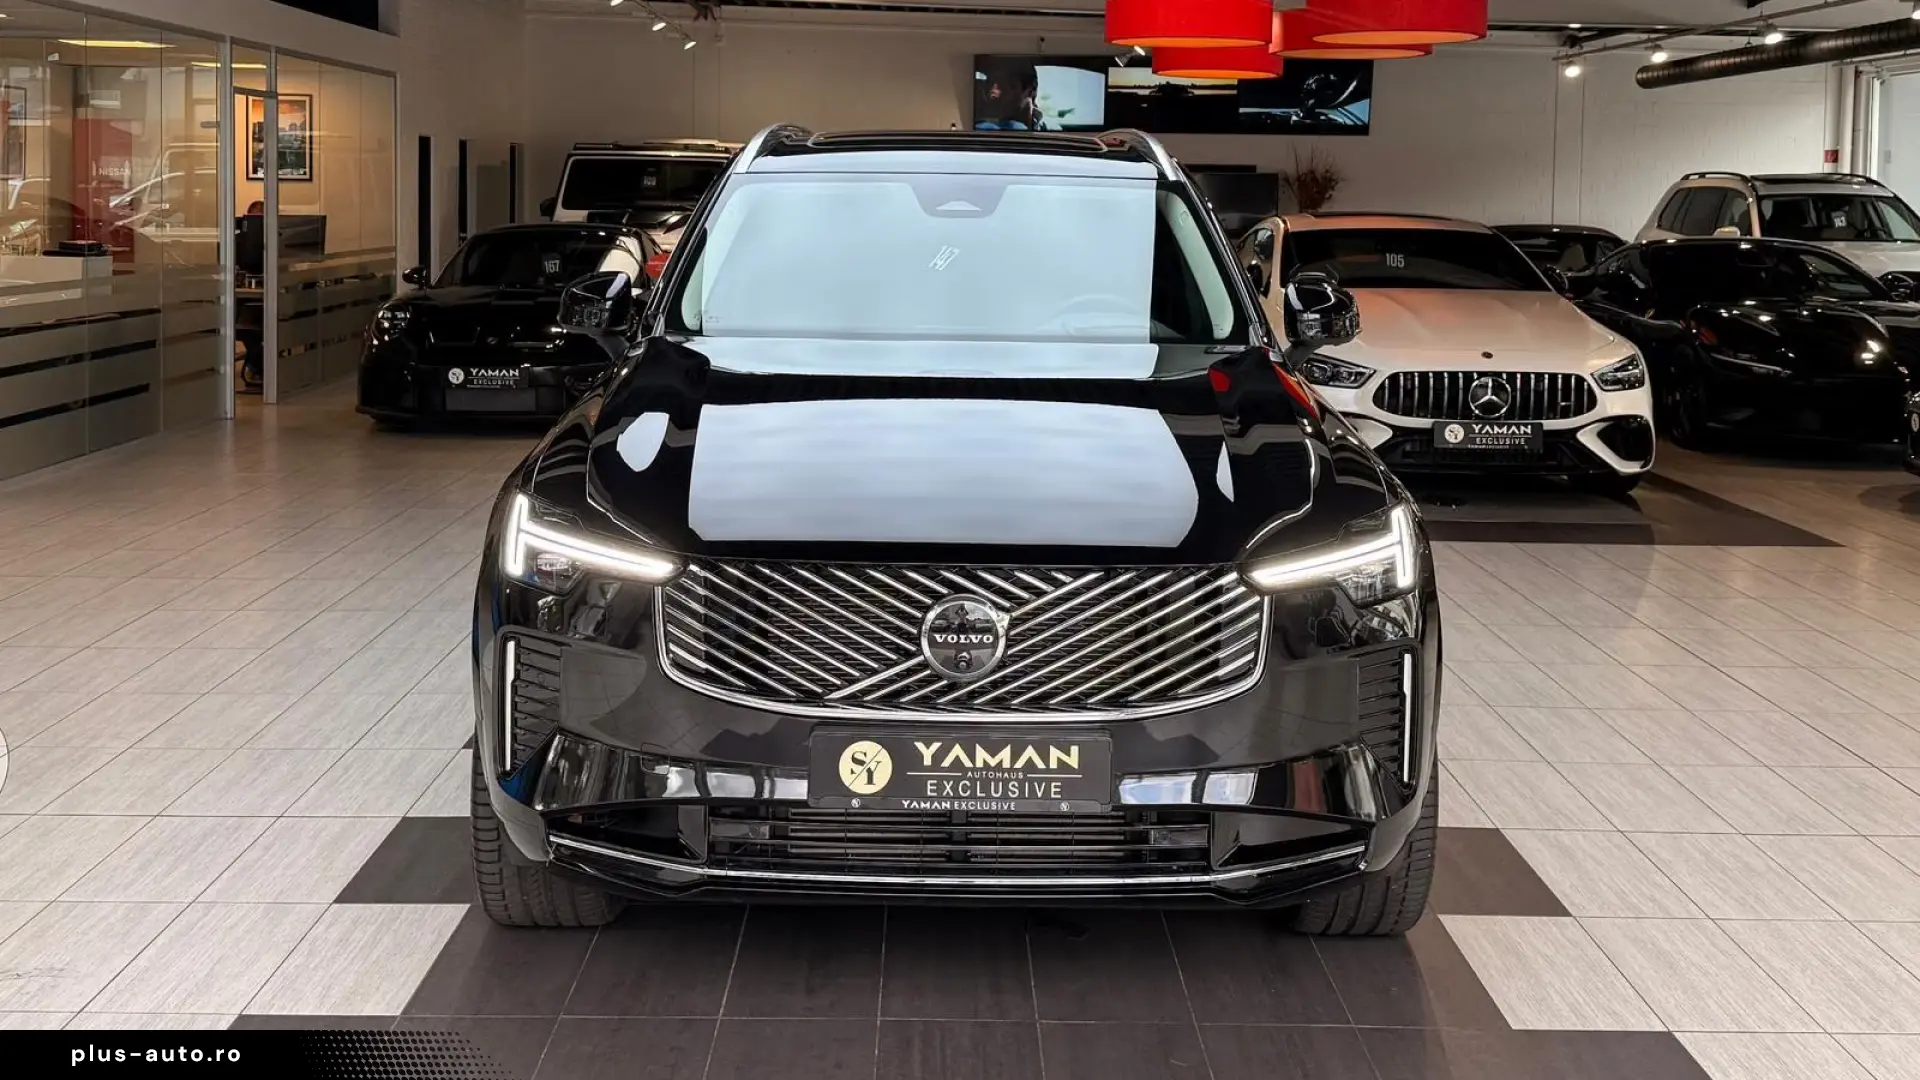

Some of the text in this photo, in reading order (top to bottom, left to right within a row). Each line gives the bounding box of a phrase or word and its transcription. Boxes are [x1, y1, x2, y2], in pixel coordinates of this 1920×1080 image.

[1386, 252, 1405, 268] 105
[470, 367, 519, 377] YAMAN
[1472, 424, 1532, 434] YAMAN
[1476, 437, 1526, 445] EXCLUSIVE
[933, 634, 994, 643] VOLVO
[914, 741, 1080, 769] YAMAN
[966, 771, 1024, 780] AUTOHAUS
[926, 780, 1063, 799] EXCLUSIVE
[902, 800, 1016, 811] YAMAN EXCLUSIVE
